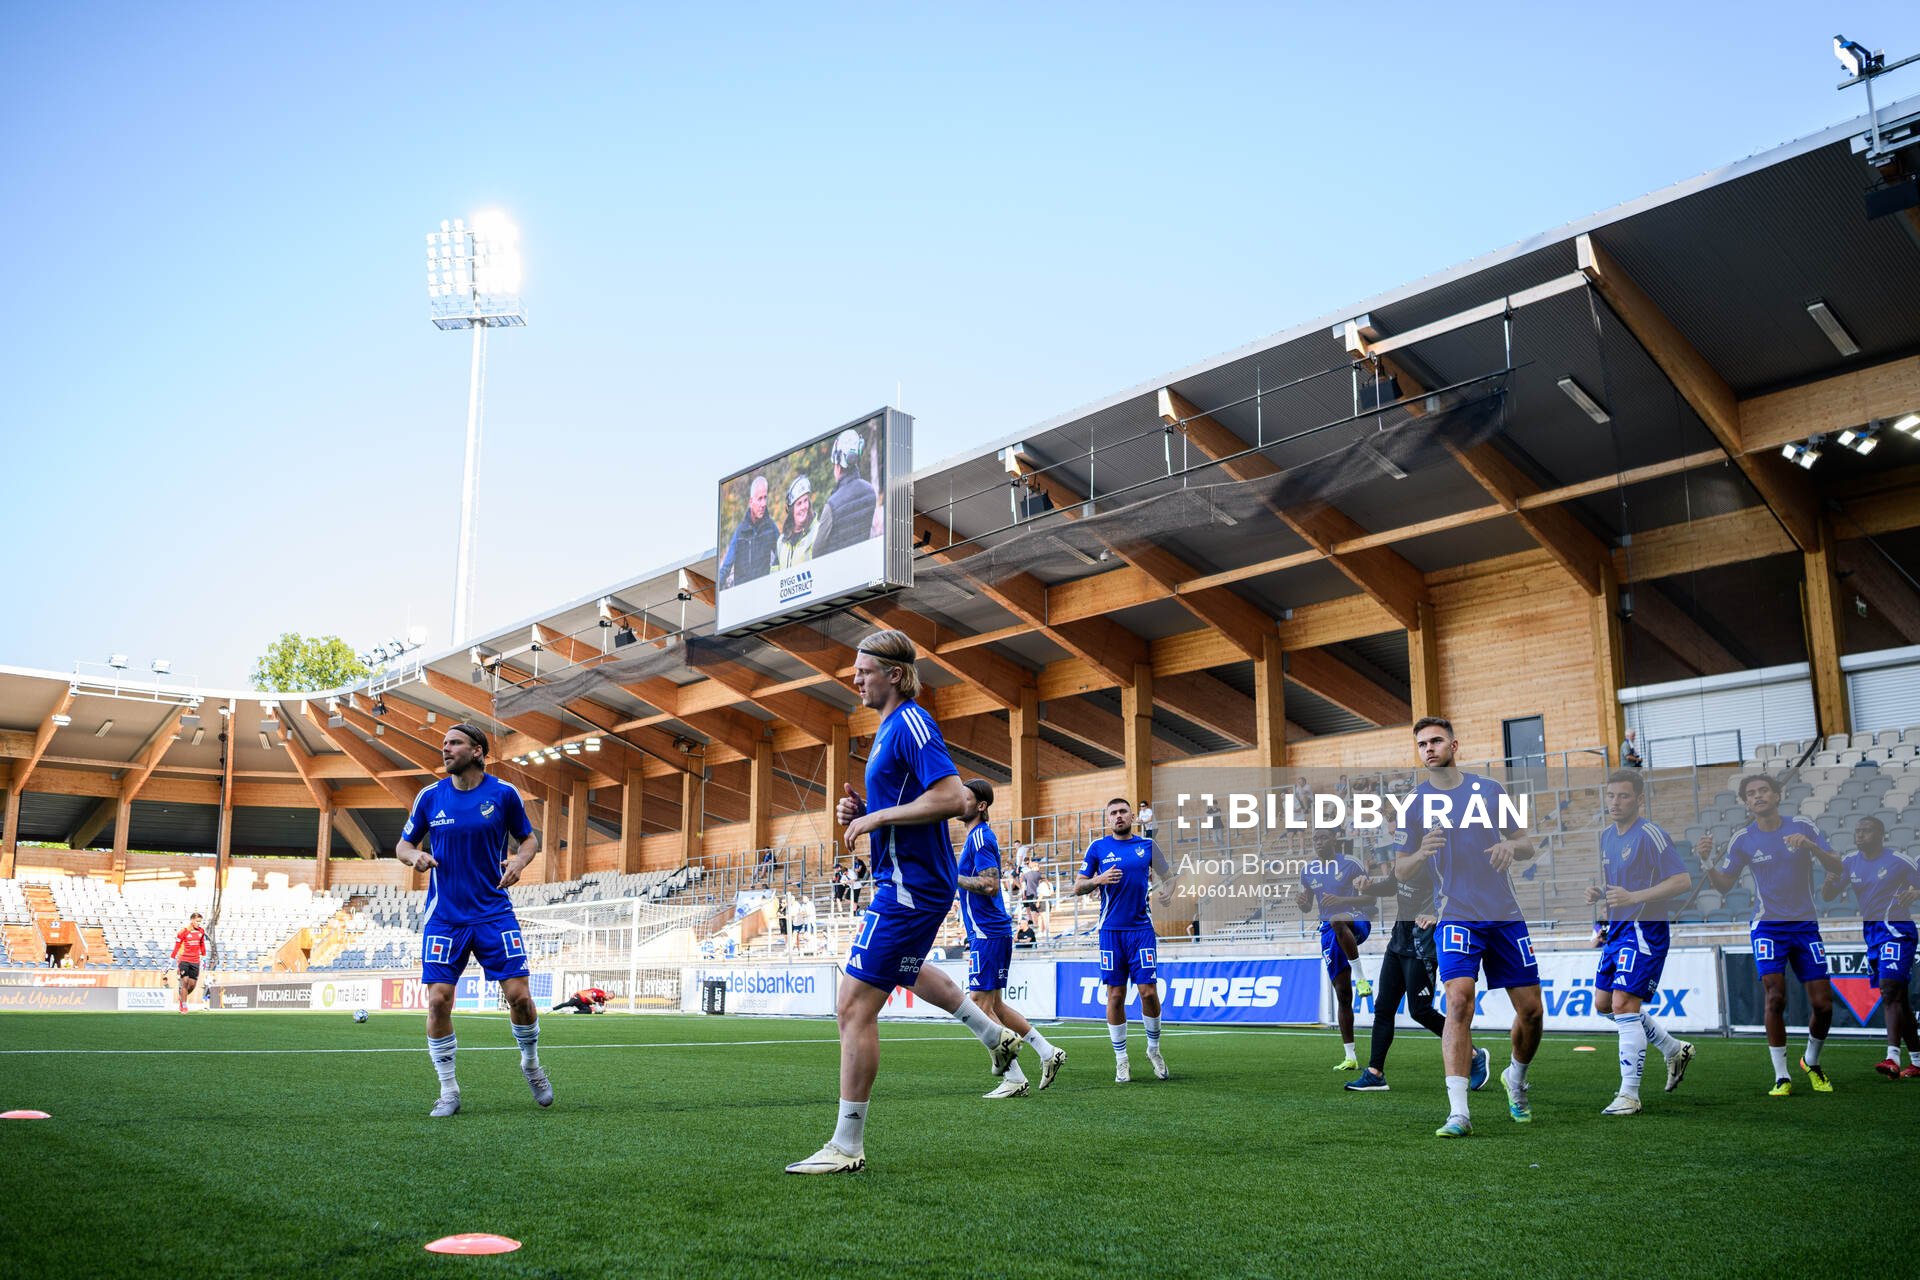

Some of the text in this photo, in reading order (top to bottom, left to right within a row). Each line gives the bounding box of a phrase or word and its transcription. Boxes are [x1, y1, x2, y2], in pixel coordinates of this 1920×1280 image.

[780, 575, 796, 588] BYGG
[780, 580, 813, 598] CONSTRUCT
[899, 965, 920, 974] zero
[1170, 976, 1283, 1008] TIRES
